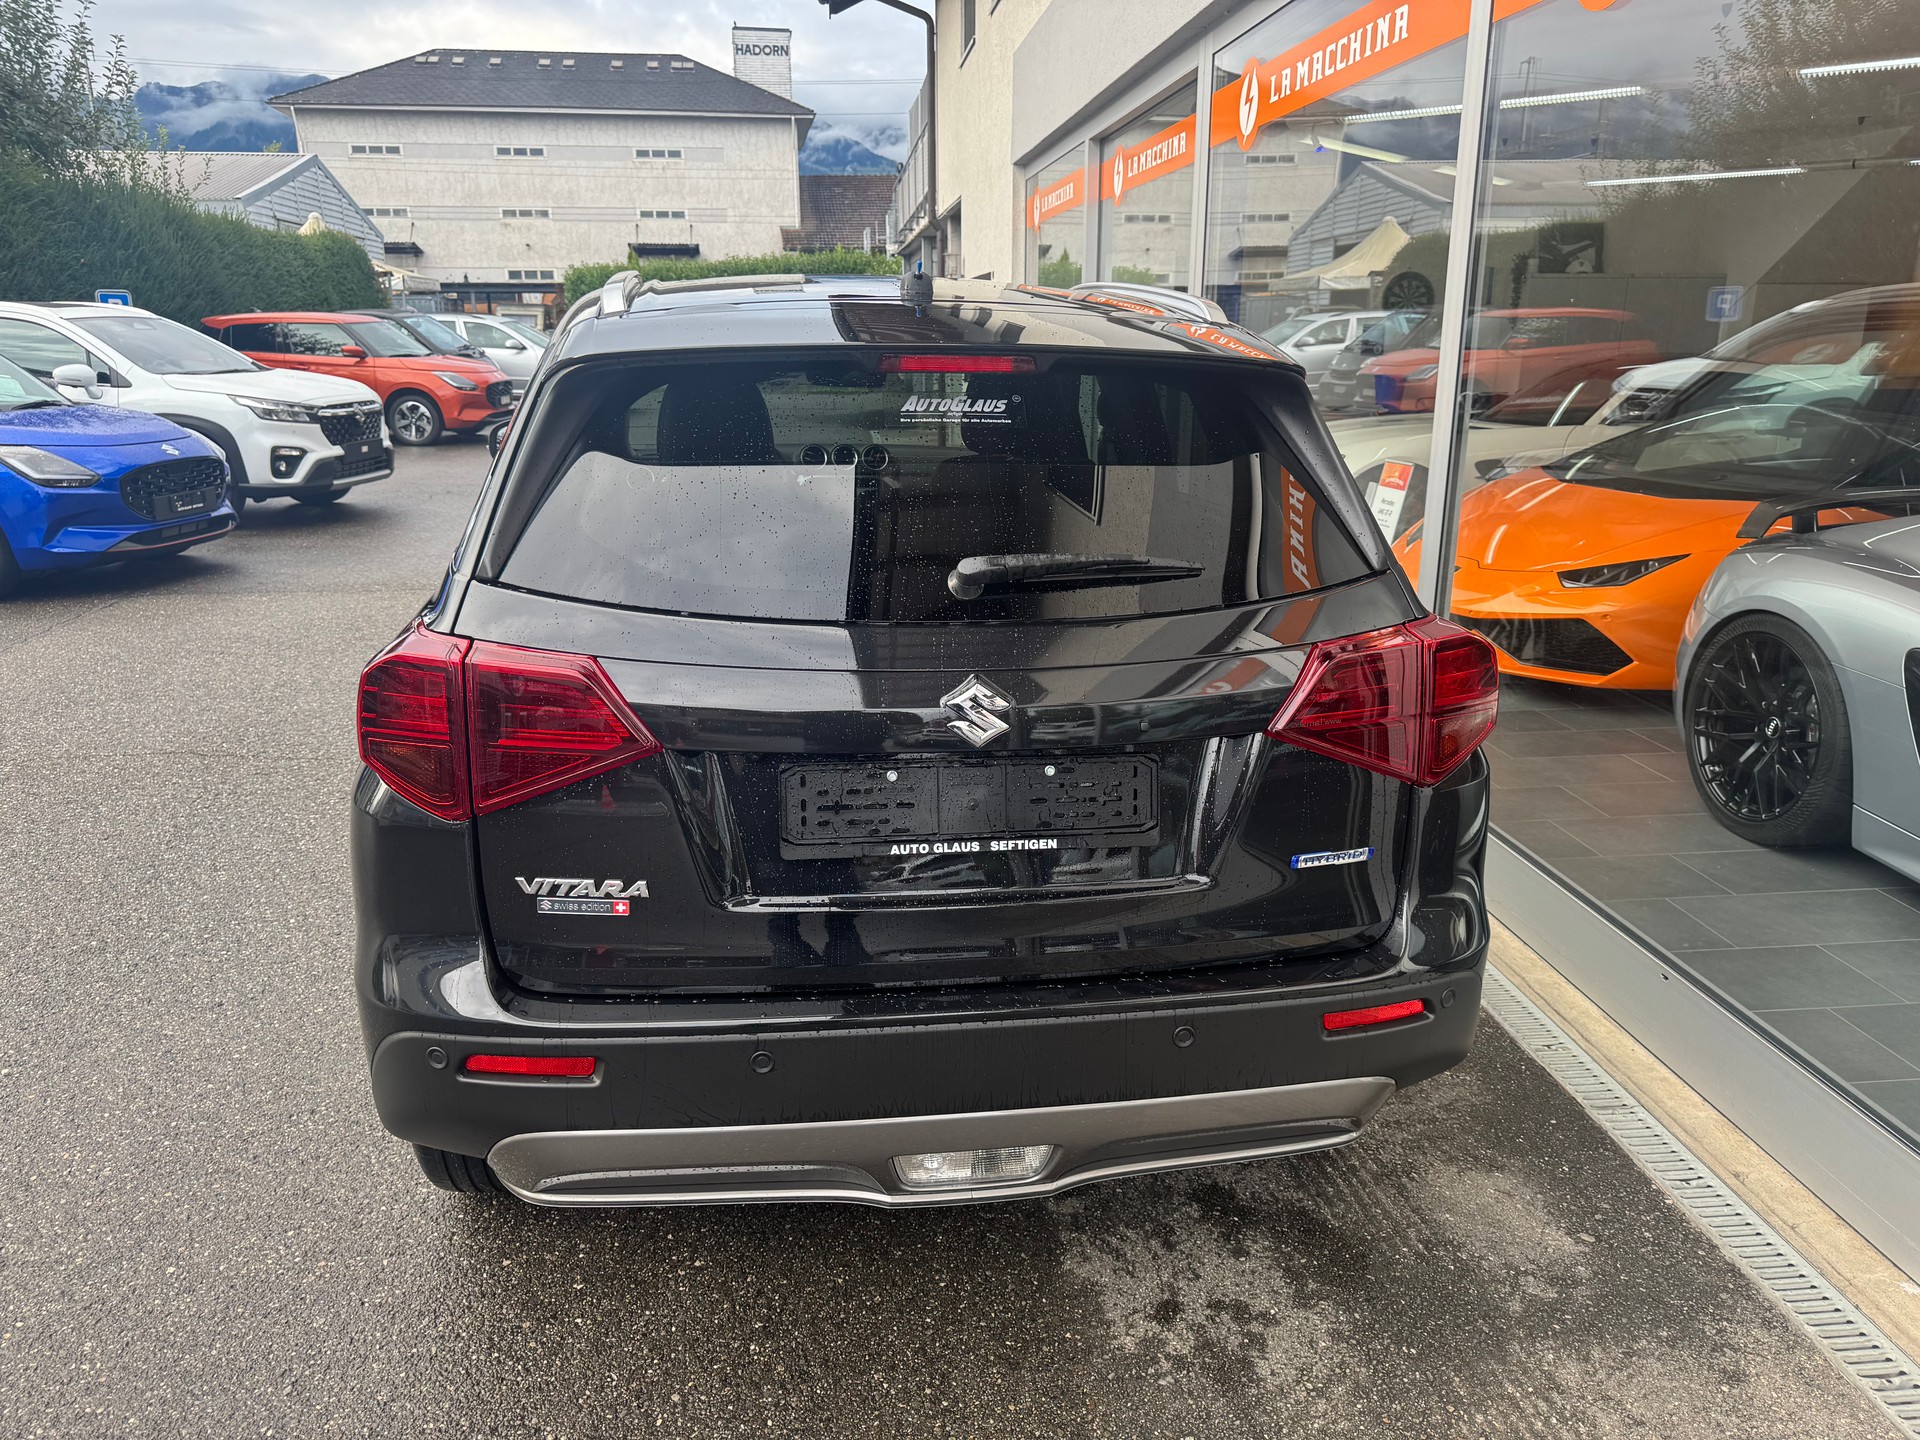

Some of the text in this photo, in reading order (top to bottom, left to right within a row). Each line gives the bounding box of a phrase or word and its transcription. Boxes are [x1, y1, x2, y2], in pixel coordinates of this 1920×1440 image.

[735, 44, 789, 57] HADORN
[1269, 4, 1409, 104] LA MACCHINA
[1127, 131, 1187, 178] LA MACCHINA
[890, 839, 1058, 855] AUTO GLAUS SEFTIGEN
[1302, 850, 1363, 865] HYBRID
[514, 877, 650, 898] VITARA
[553, 902, 611, 912] swiss edition
